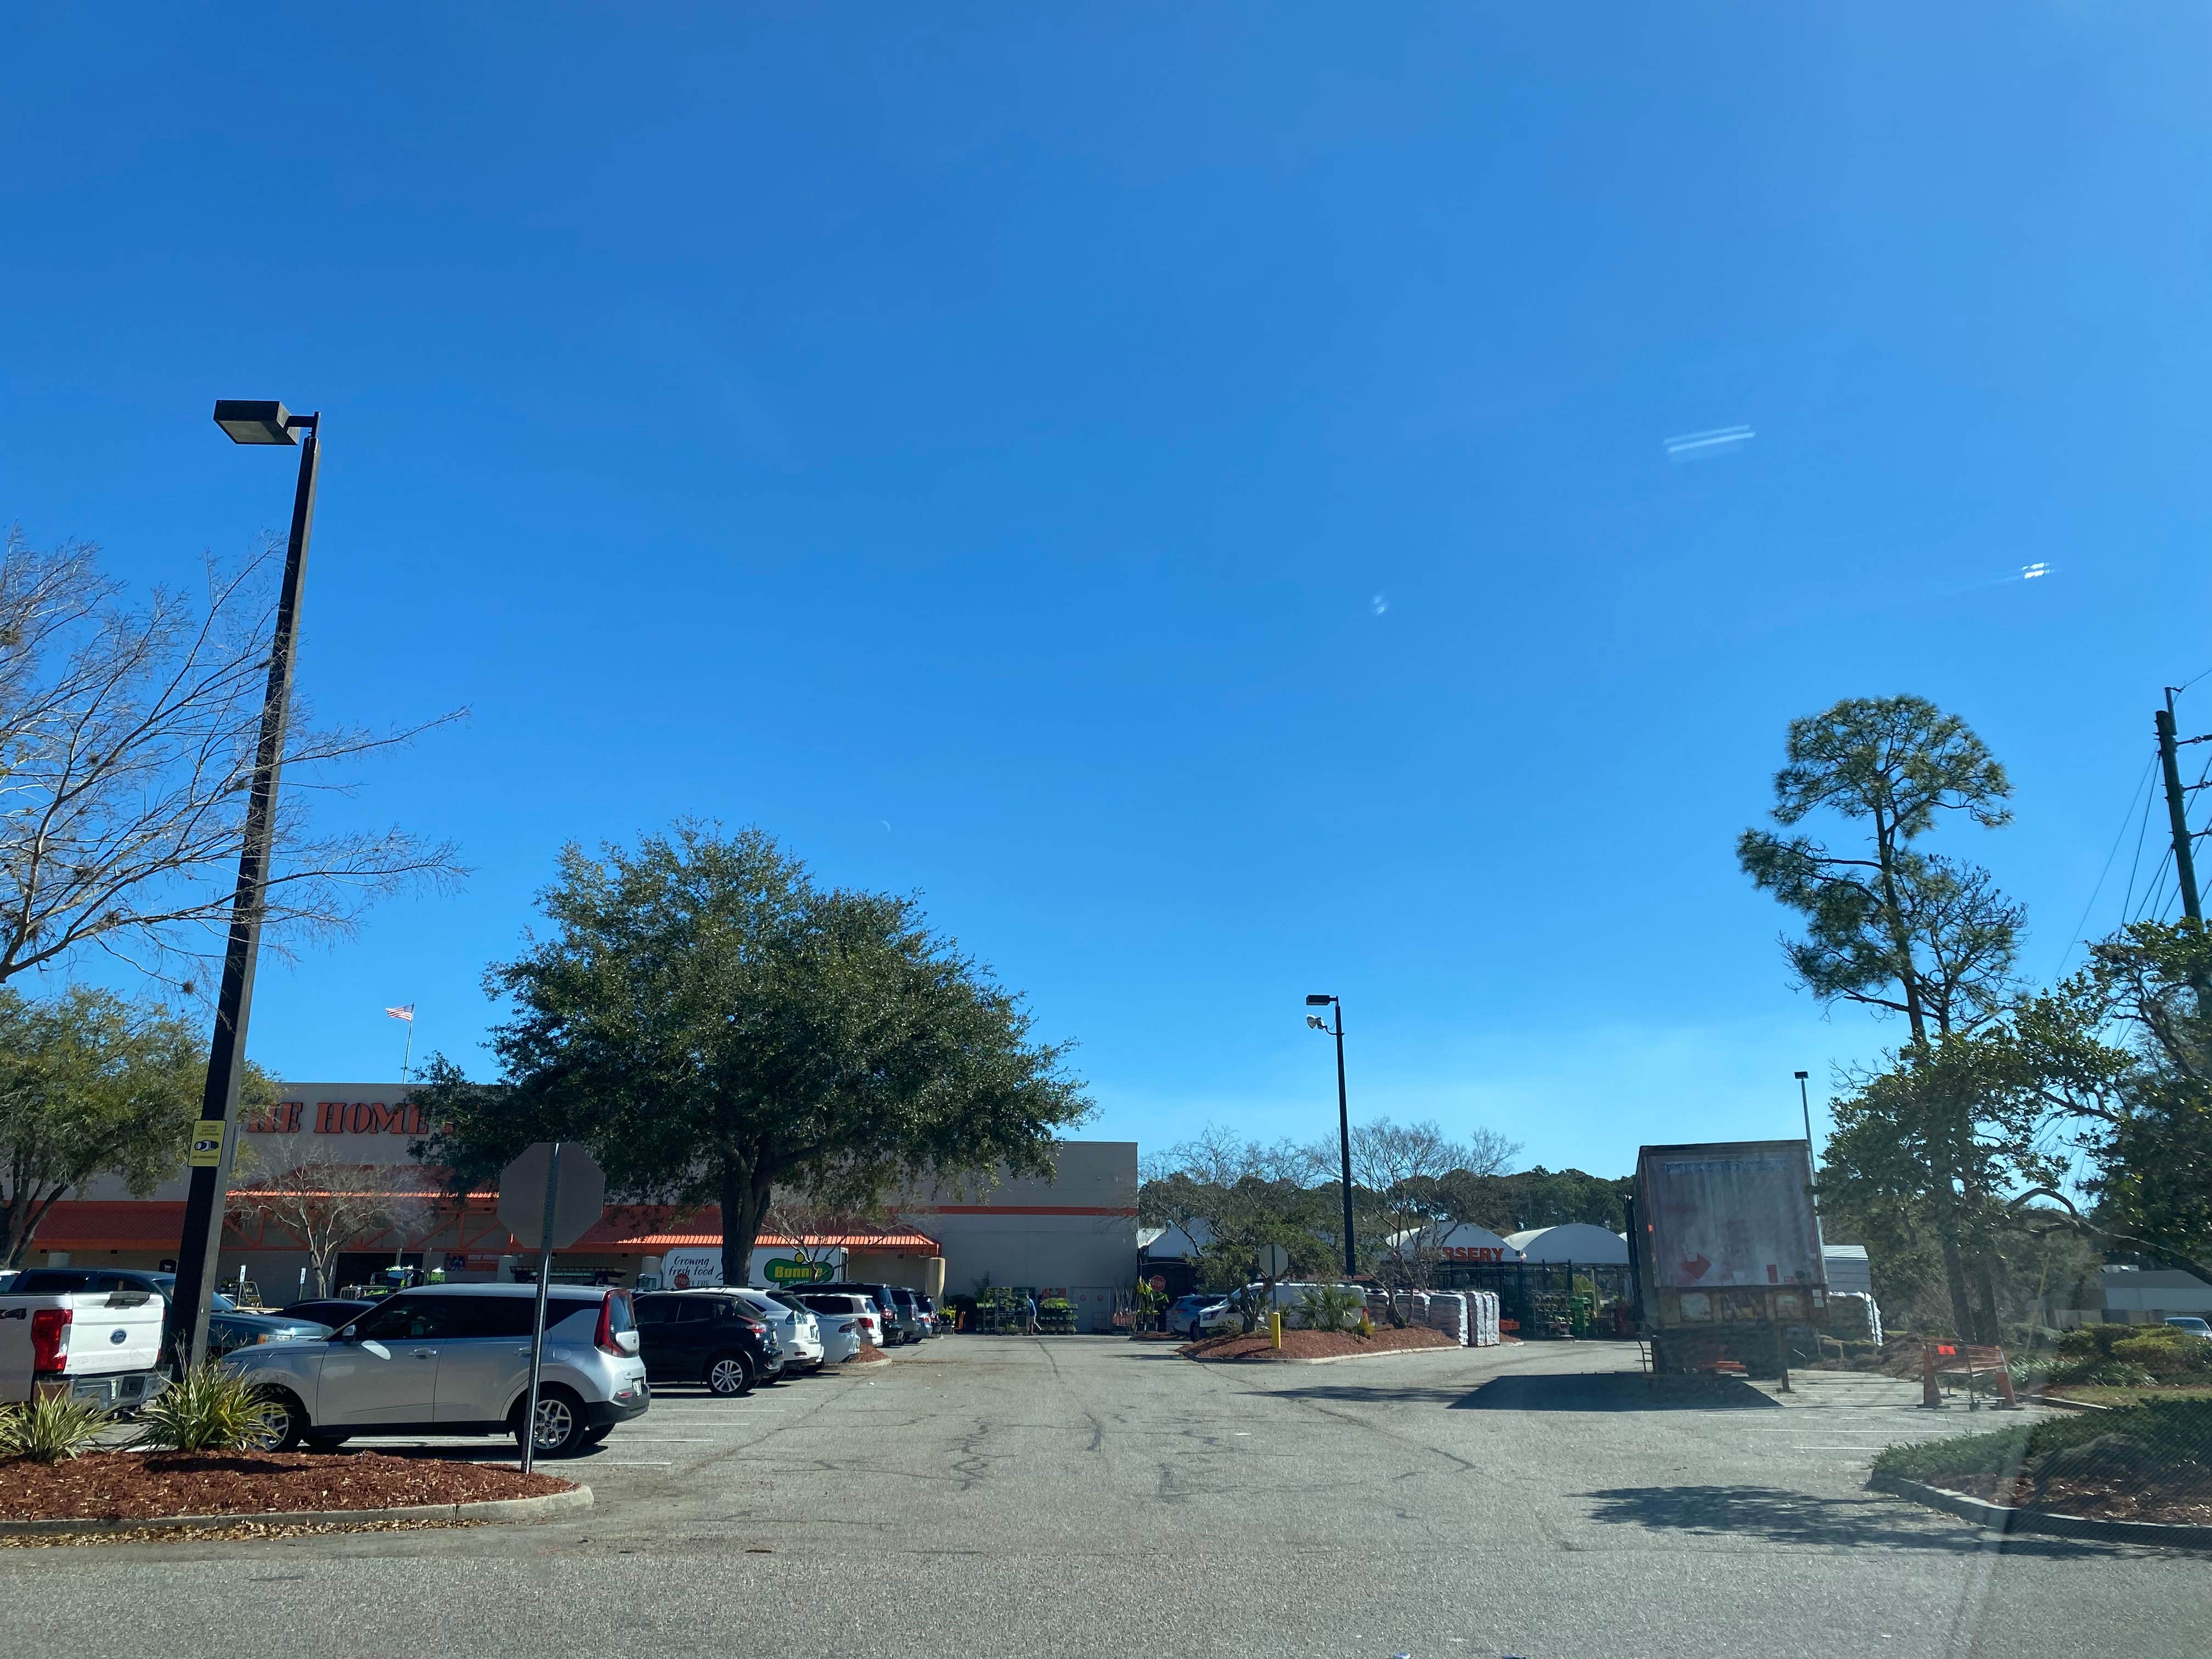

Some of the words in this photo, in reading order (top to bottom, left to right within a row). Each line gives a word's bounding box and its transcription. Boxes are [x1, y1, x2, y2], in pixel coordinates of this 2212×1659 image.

[313, 1102, 430, 1134] HOME
[1422, 1246, 1505, 1262] RSERY
[674, 1256, 710, 1268] Growing
[668, 1266, 691, 1276] fresh
[693, 1266, 714, 1276] food
[774, 1266, 823, 1278] Bonne
[1151, 1279, 1165, 1287] STOP
